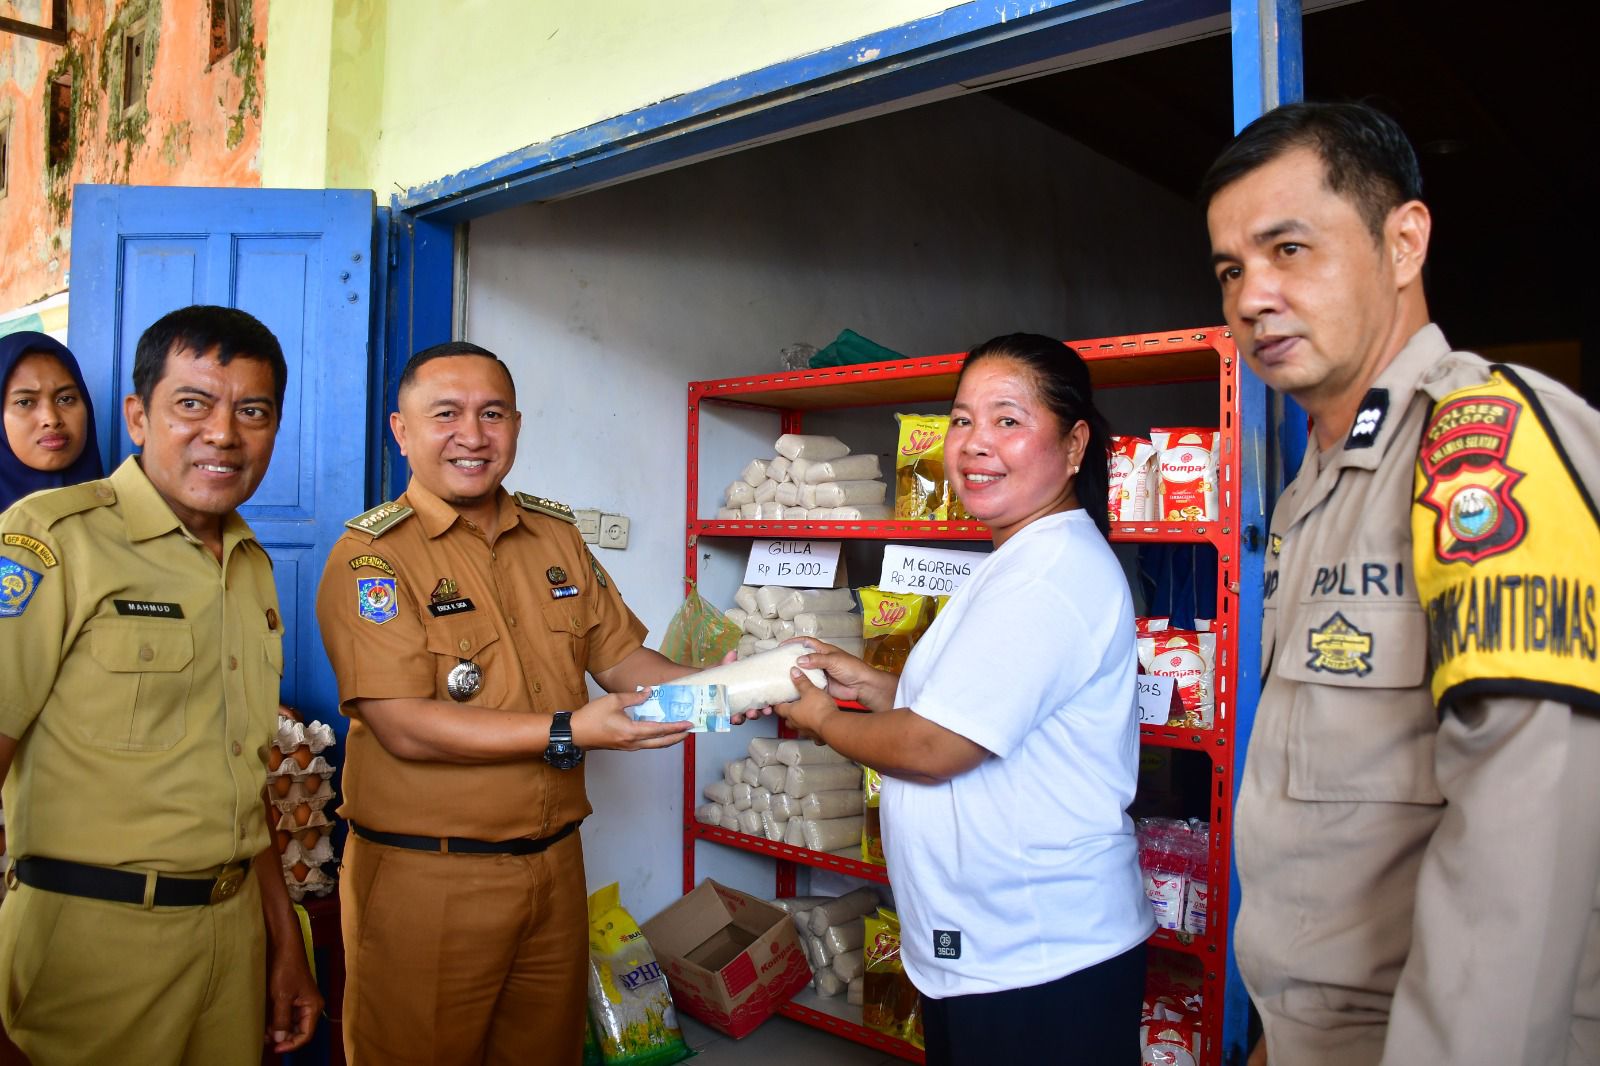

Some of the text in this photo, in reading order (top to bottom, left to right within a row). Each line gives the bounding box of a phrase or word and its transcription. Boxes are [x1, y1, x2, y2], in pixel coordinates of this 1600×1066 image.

[768, 541, 811, 555] GULA
[758, 563, 771, 576] Rp
[1311, 562, 1404, 596] POLRI
[128, 603, 170, 613] MAHMUD
[761, 942, 797, 974] Kompas
